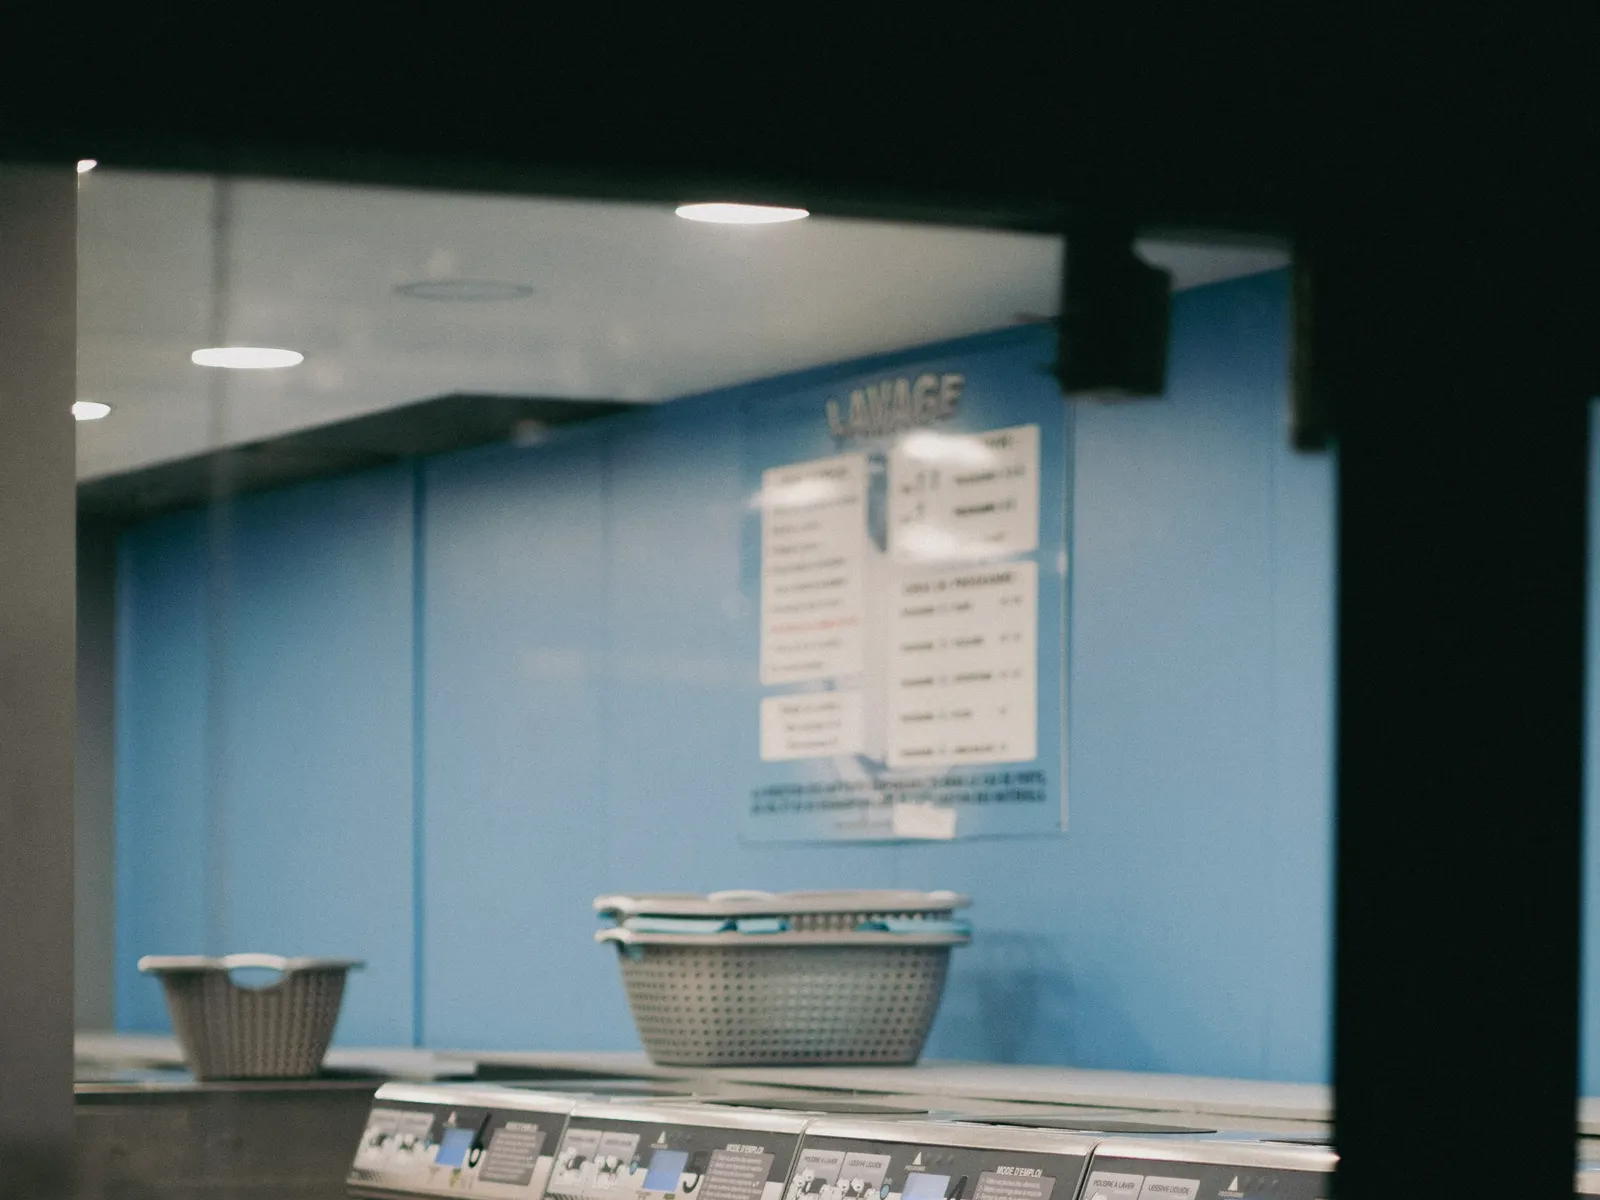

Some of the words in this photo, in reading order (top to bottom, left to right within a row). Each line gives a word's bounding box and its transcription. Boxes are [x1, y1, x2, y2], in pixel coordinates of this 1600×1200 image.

[824, 370, 968, 438] LAVAGE
[468, 1112, 493, 1168] 6
[996, 1165, 1014, 1176] MODE
[1014, 1167, 1044, 1179] D'EMPLOI
